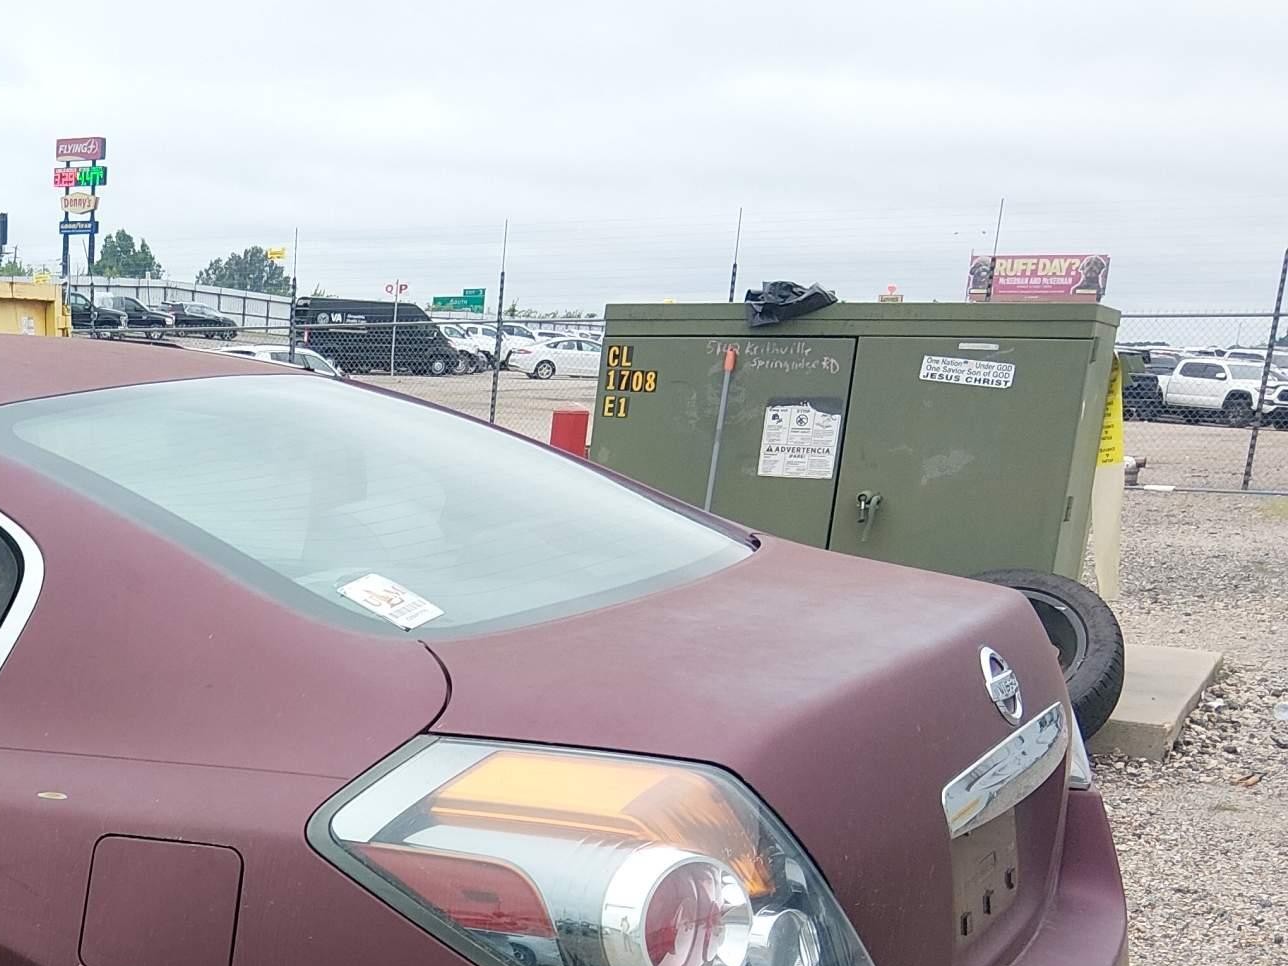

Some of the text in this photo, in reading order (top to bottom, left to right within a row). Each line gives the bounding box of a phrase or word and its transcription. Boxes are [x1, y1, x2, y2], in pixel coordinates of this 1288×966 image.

[58, 143, 87, 154] FLYING
[994, 258, 1080, 276] RUFF DAY?
[331, 313, 342, 322] VA
[608, 345, 632, 367] CL
[926, 364, 940, 372] One
[992, 371, 1010, 379] GOD
[975, 362, 995, 370] Under
[996, 364, 1013, 372] GOD
[606, 370, 656, 392] 1708
[922, 372, 1011, 387] JESUS CHRIST
[603, 396, 626, 417] E1
[775, 446, 830, 454] ADVERTENCIA
